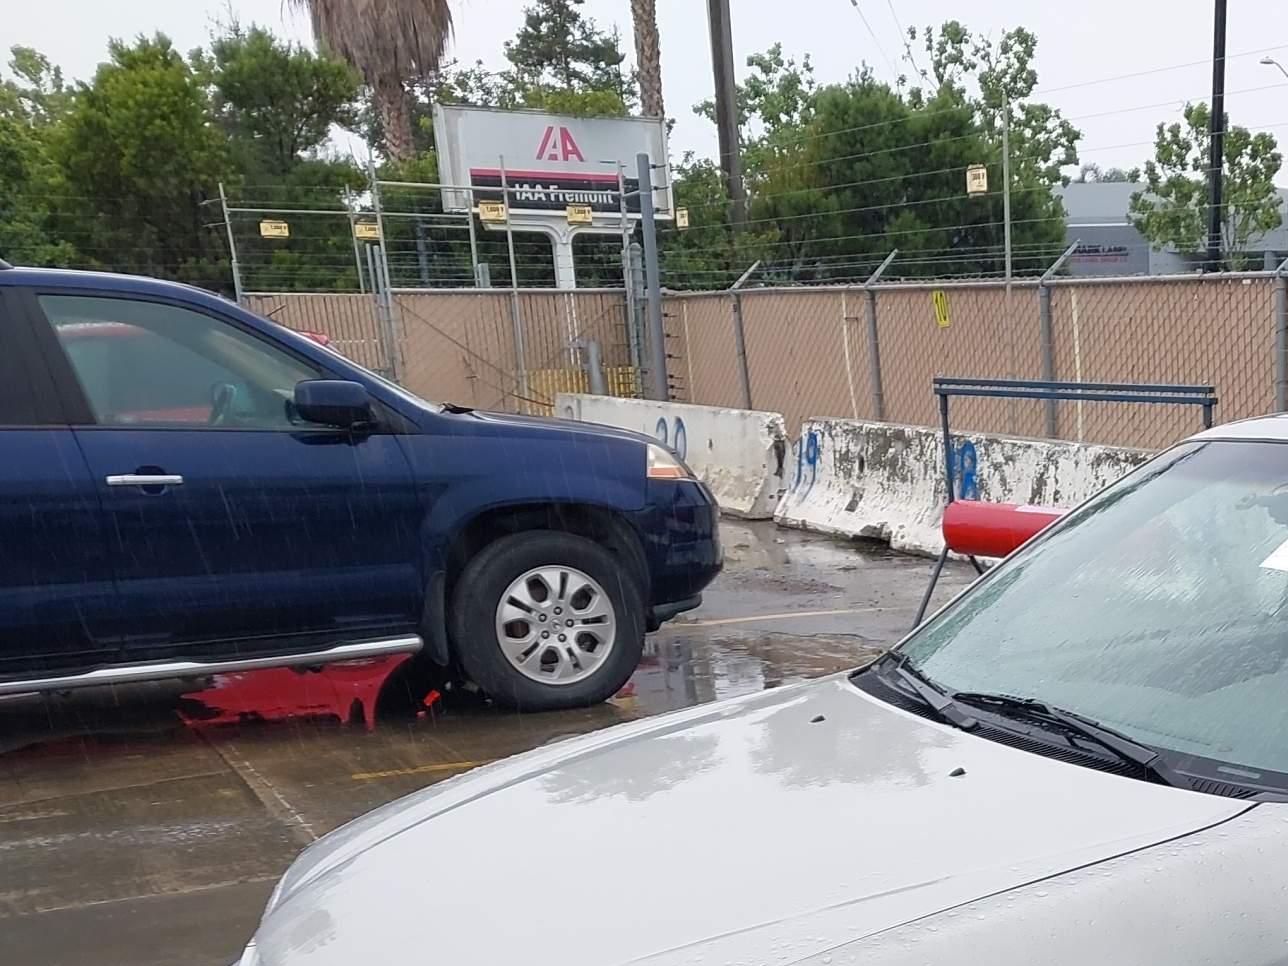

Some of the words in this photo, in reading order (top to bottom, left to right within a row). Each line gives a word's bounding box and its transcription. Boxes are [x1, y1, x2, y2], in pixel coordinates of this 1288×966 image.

[514, 183, 547, 201] IAA
[548, 184, 614, 204] Fremont
[935, 291, 947, 322] 10
